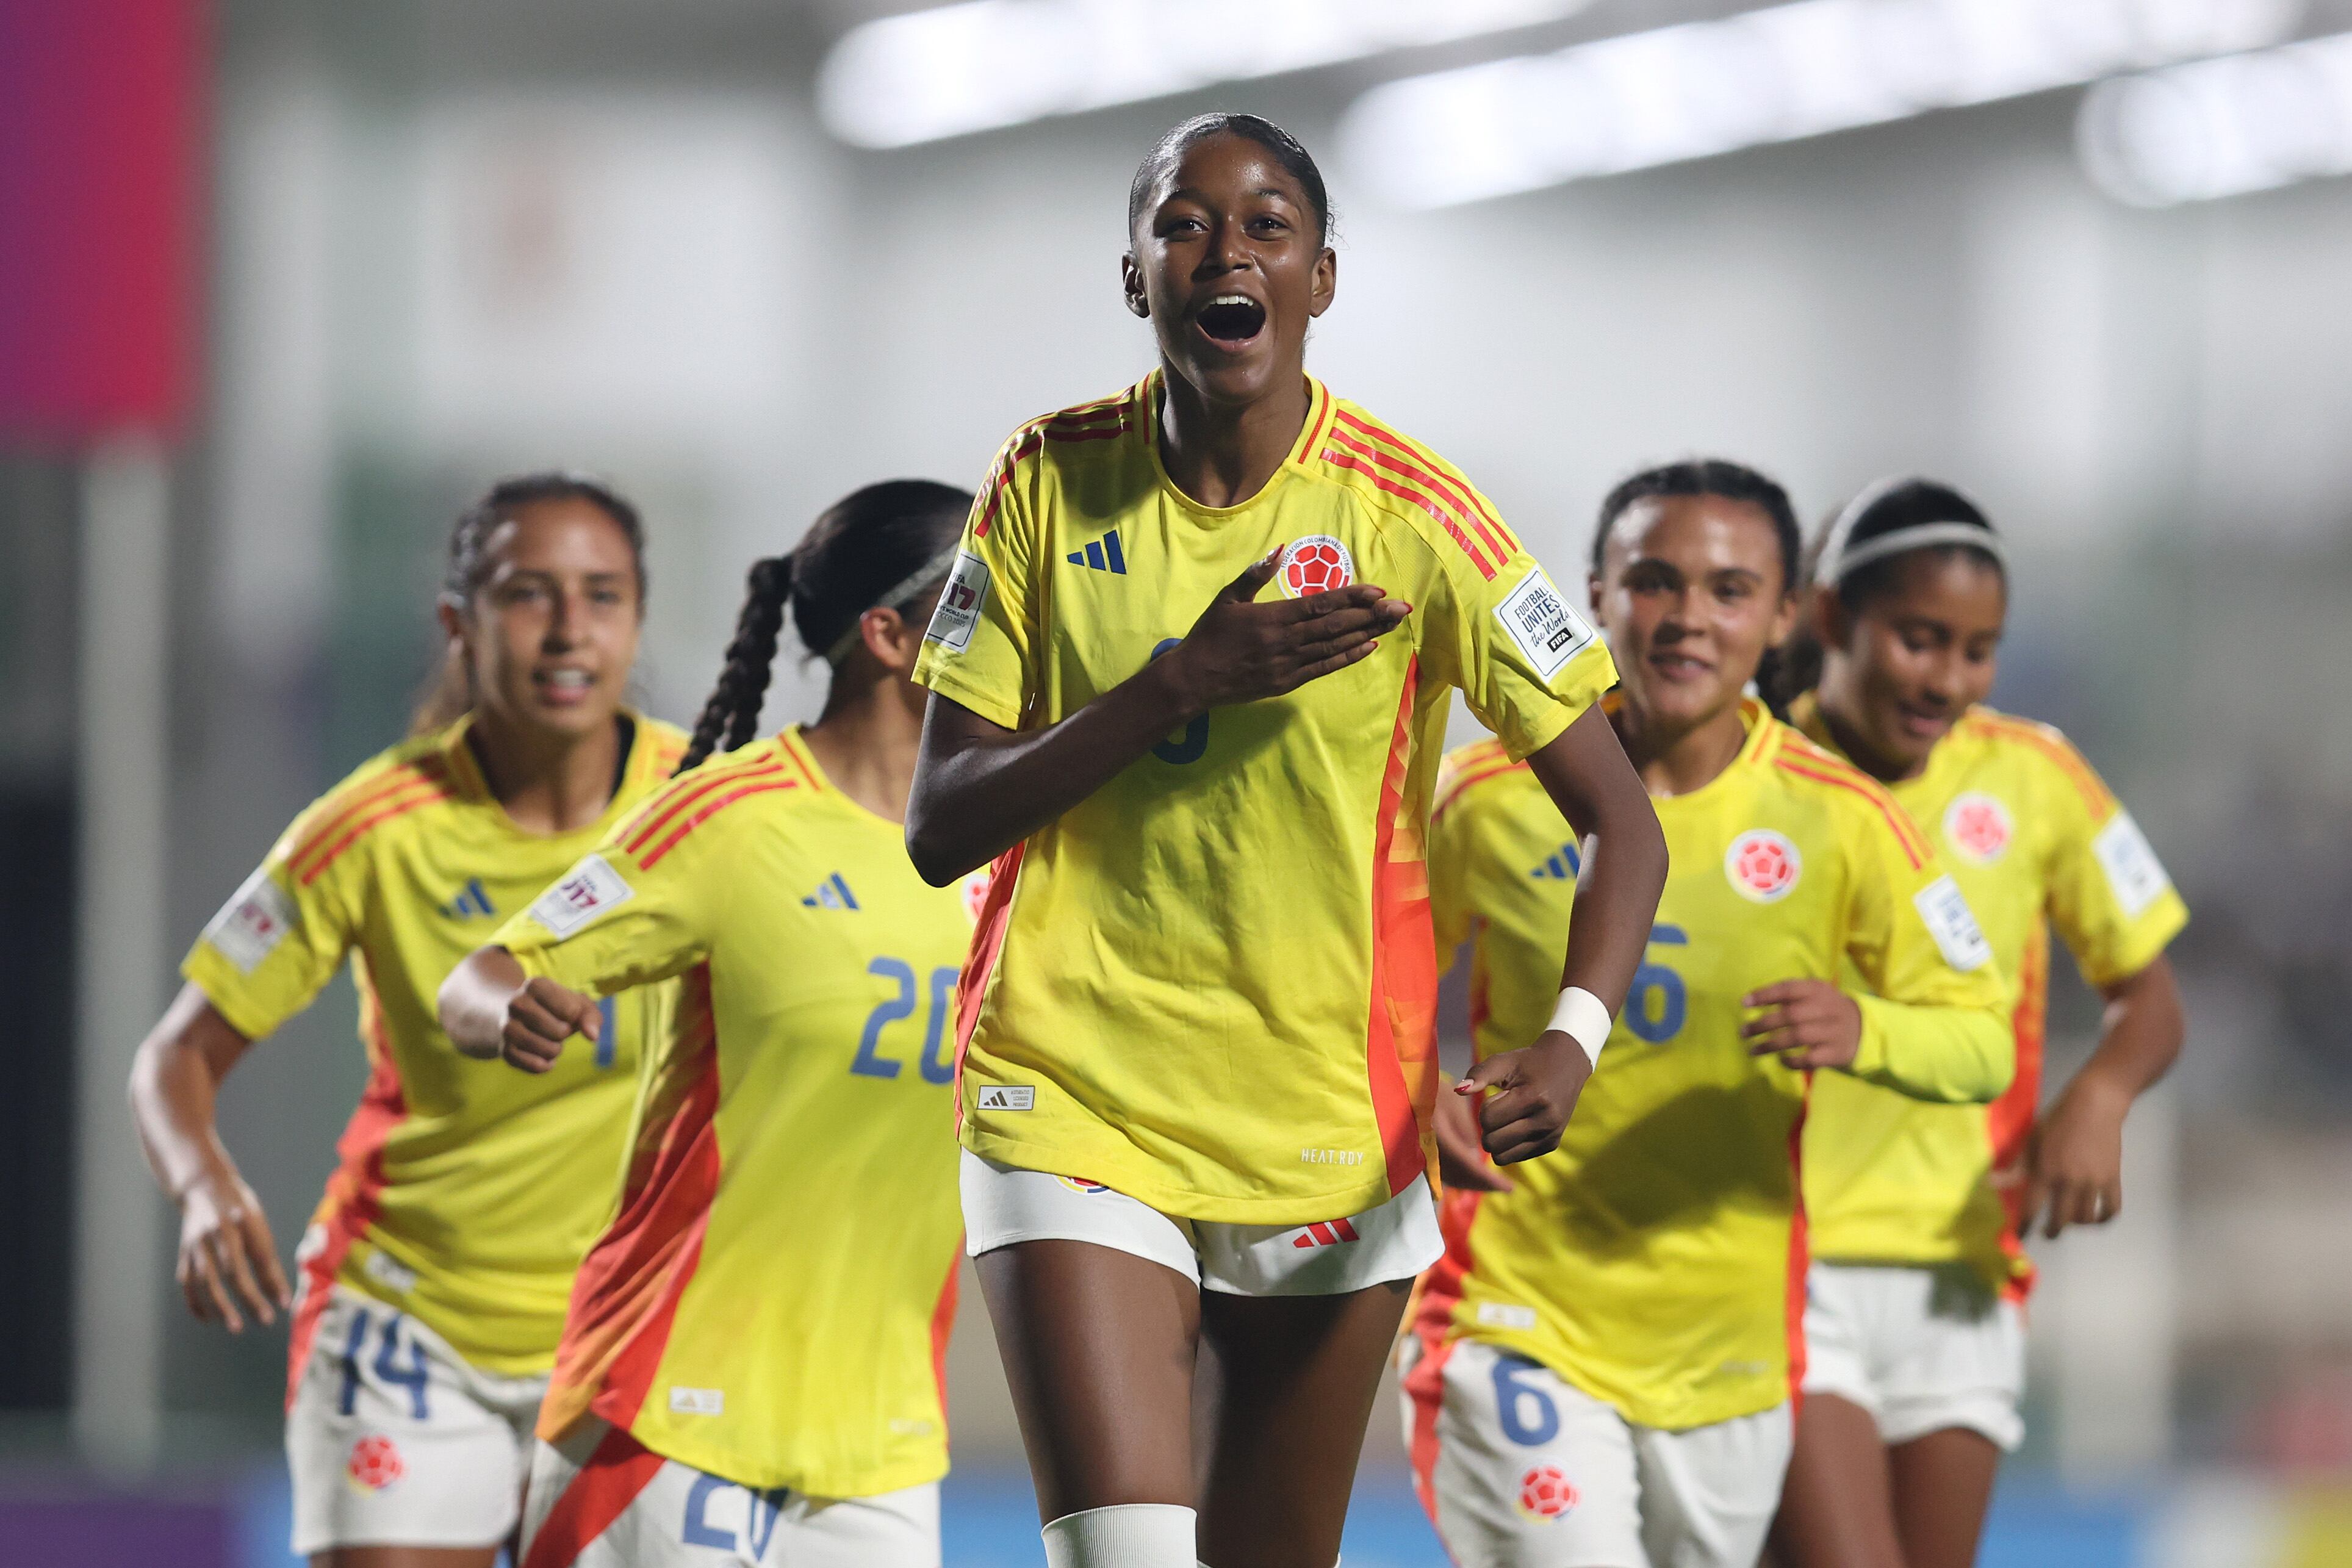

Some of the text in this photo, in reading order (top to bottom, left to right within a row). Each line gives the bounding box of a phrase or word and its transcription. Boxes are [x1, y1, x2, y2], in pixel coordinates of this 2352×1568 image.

[1514, 584, 1549, 620] FOOTBALL
[1522, 594, 1560, 633] UNITES
[1530, 606, 1572, 648] the World
[1549, 630, 1570, 650] FIFA
[1624, 923, 1688, 1045] 6
[1301, 1148, 1364, 1166] HEAT.RDY
[339, 1307, 430, 1420] 14
[1492, 1356, 1559, 1447] 6
